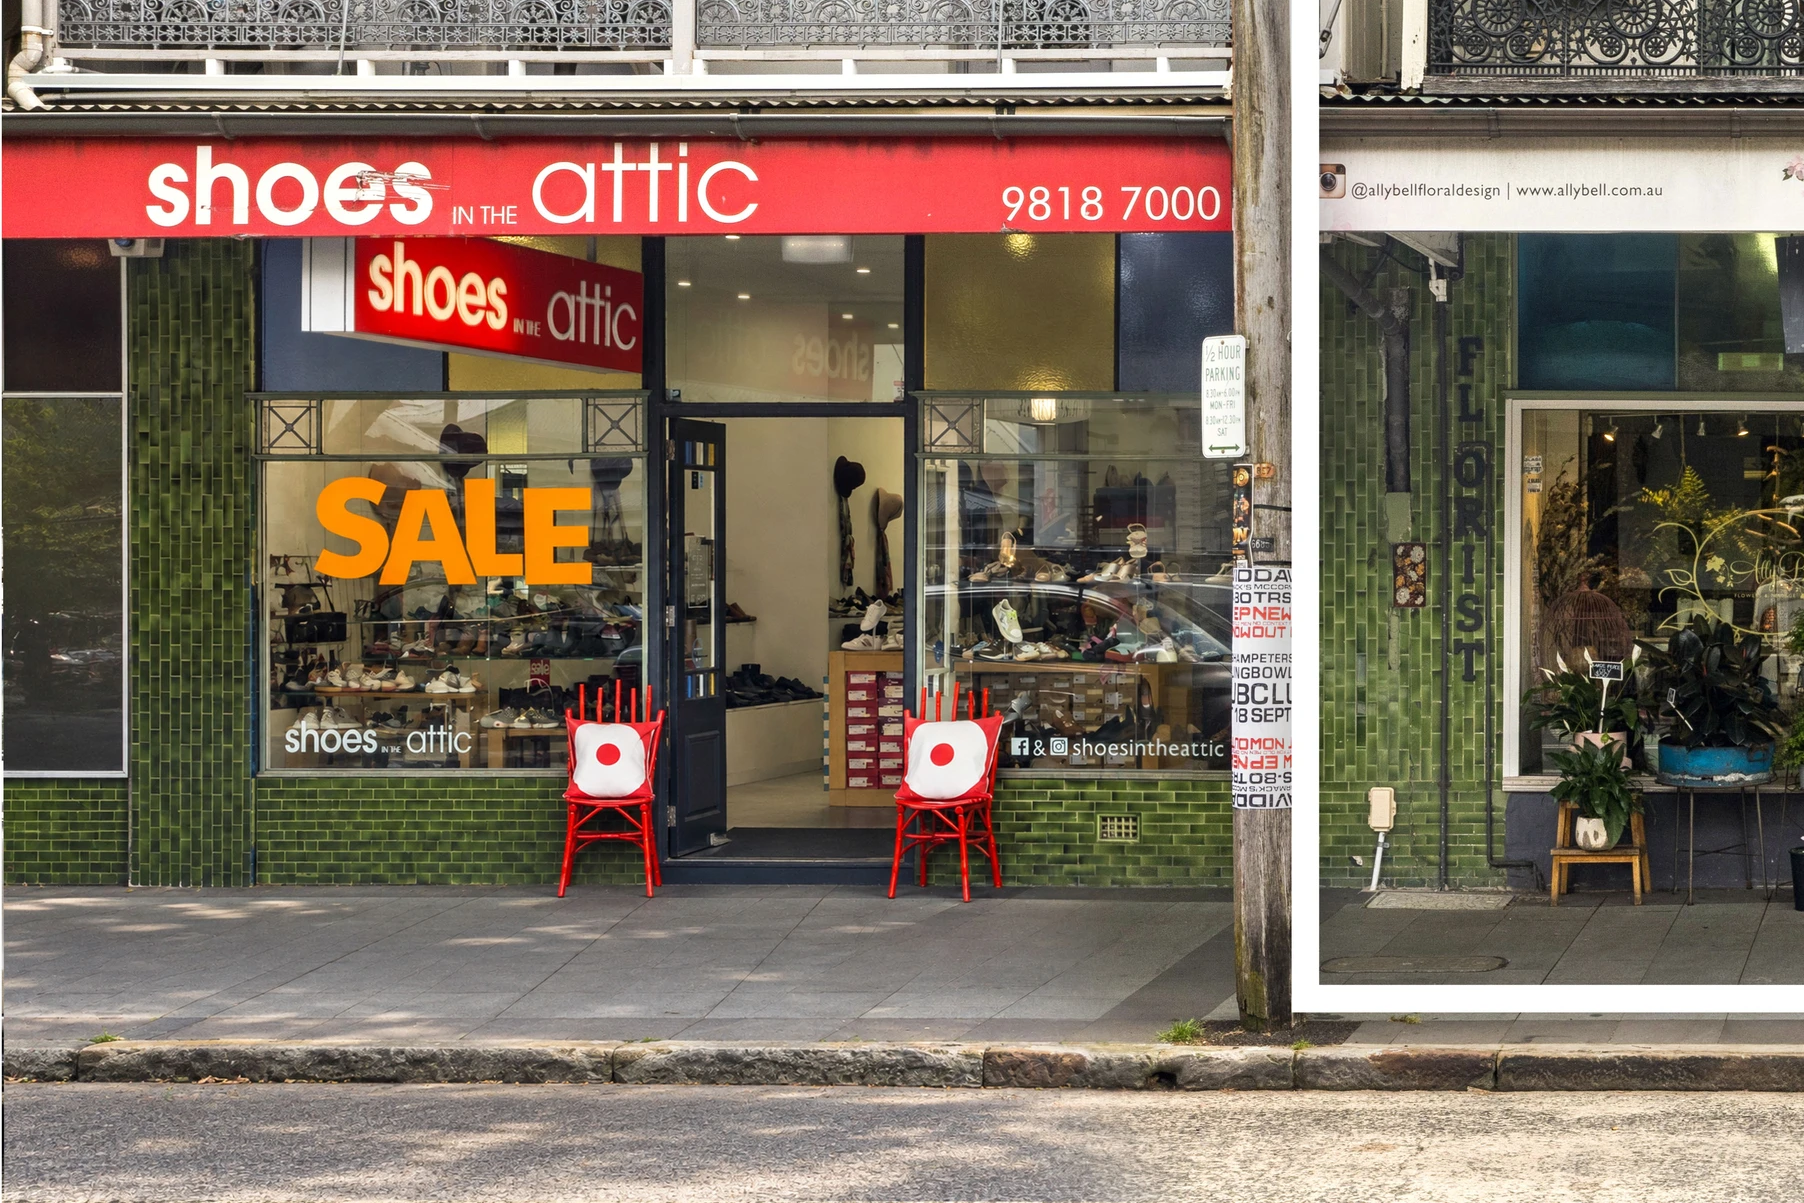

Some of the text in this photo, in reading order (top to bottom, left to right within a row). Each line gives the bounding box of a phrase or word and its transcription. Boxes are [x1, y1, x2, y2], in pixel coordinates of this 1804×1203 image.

[147, 143, 759, 227] shoes IN THE attic
[1351, 182, 1663, 200] @allybellfloraldesign www.allybell.com.au
[1002, 185, 1221, 221] 9818 7000
[367, 241, 507, 330] shoes
[547, 281, 636, 350] attic
[1218, 345, 1241, 359] HOUR
[1205, 366, 1240, 382] PARKING
[1217, 428, 1228, 436] SAT
[1455, 336, 1486, 682] FLORIST
[314, 476, 593, 585] SALE
[285, 721, 378, 754] shoes
[406, 725, 472, 754] attic
[1072, 737, 1225, 759] shoesintheattic
